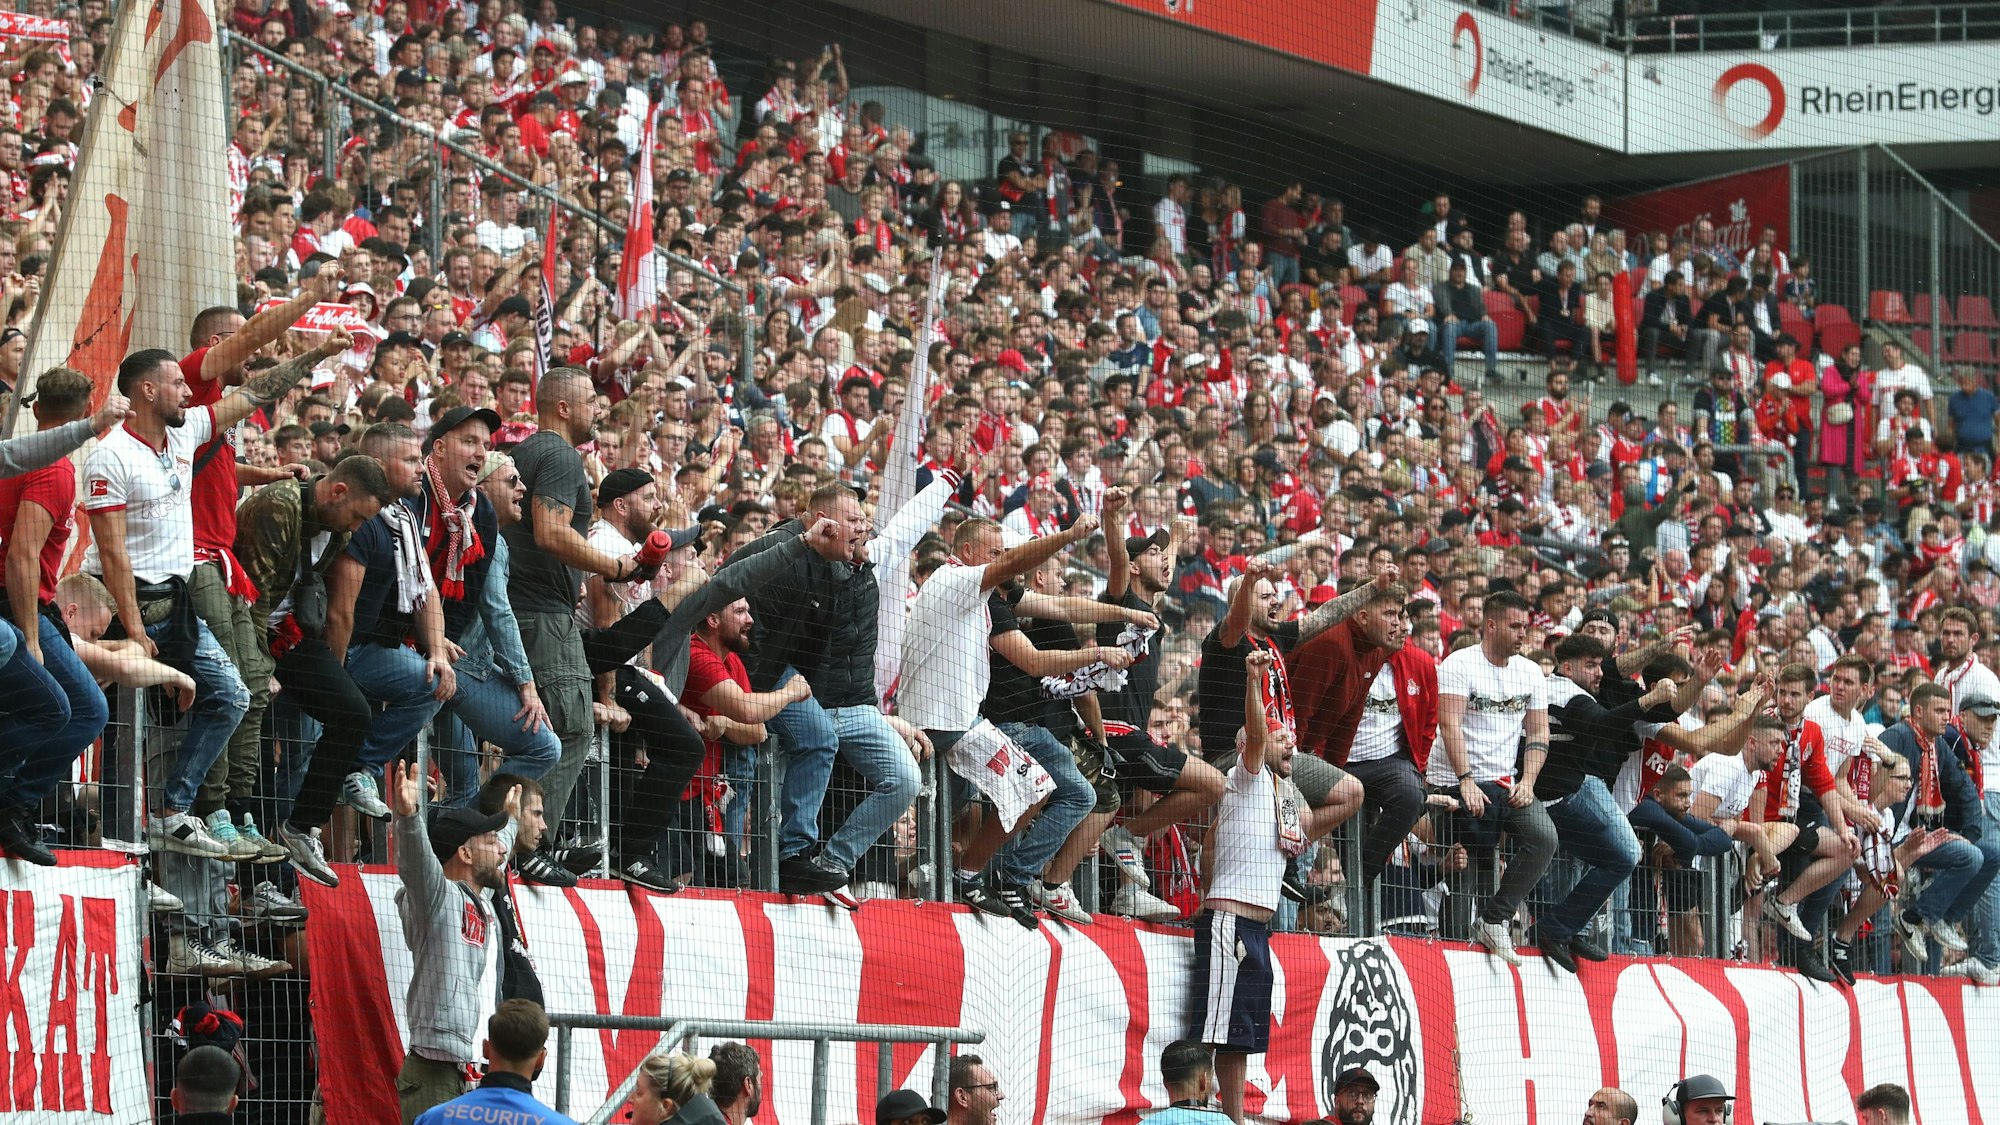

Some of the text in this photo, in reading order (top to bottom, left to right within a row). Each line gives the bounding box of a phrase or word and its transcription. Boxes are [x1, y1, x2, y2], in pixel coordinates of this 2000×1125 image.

[1487, 46, 1575, 107] RheinEnergie
[1442, 948, 2000, 1125] HORD
[443, 1103, 546, 1125] SECURITY
